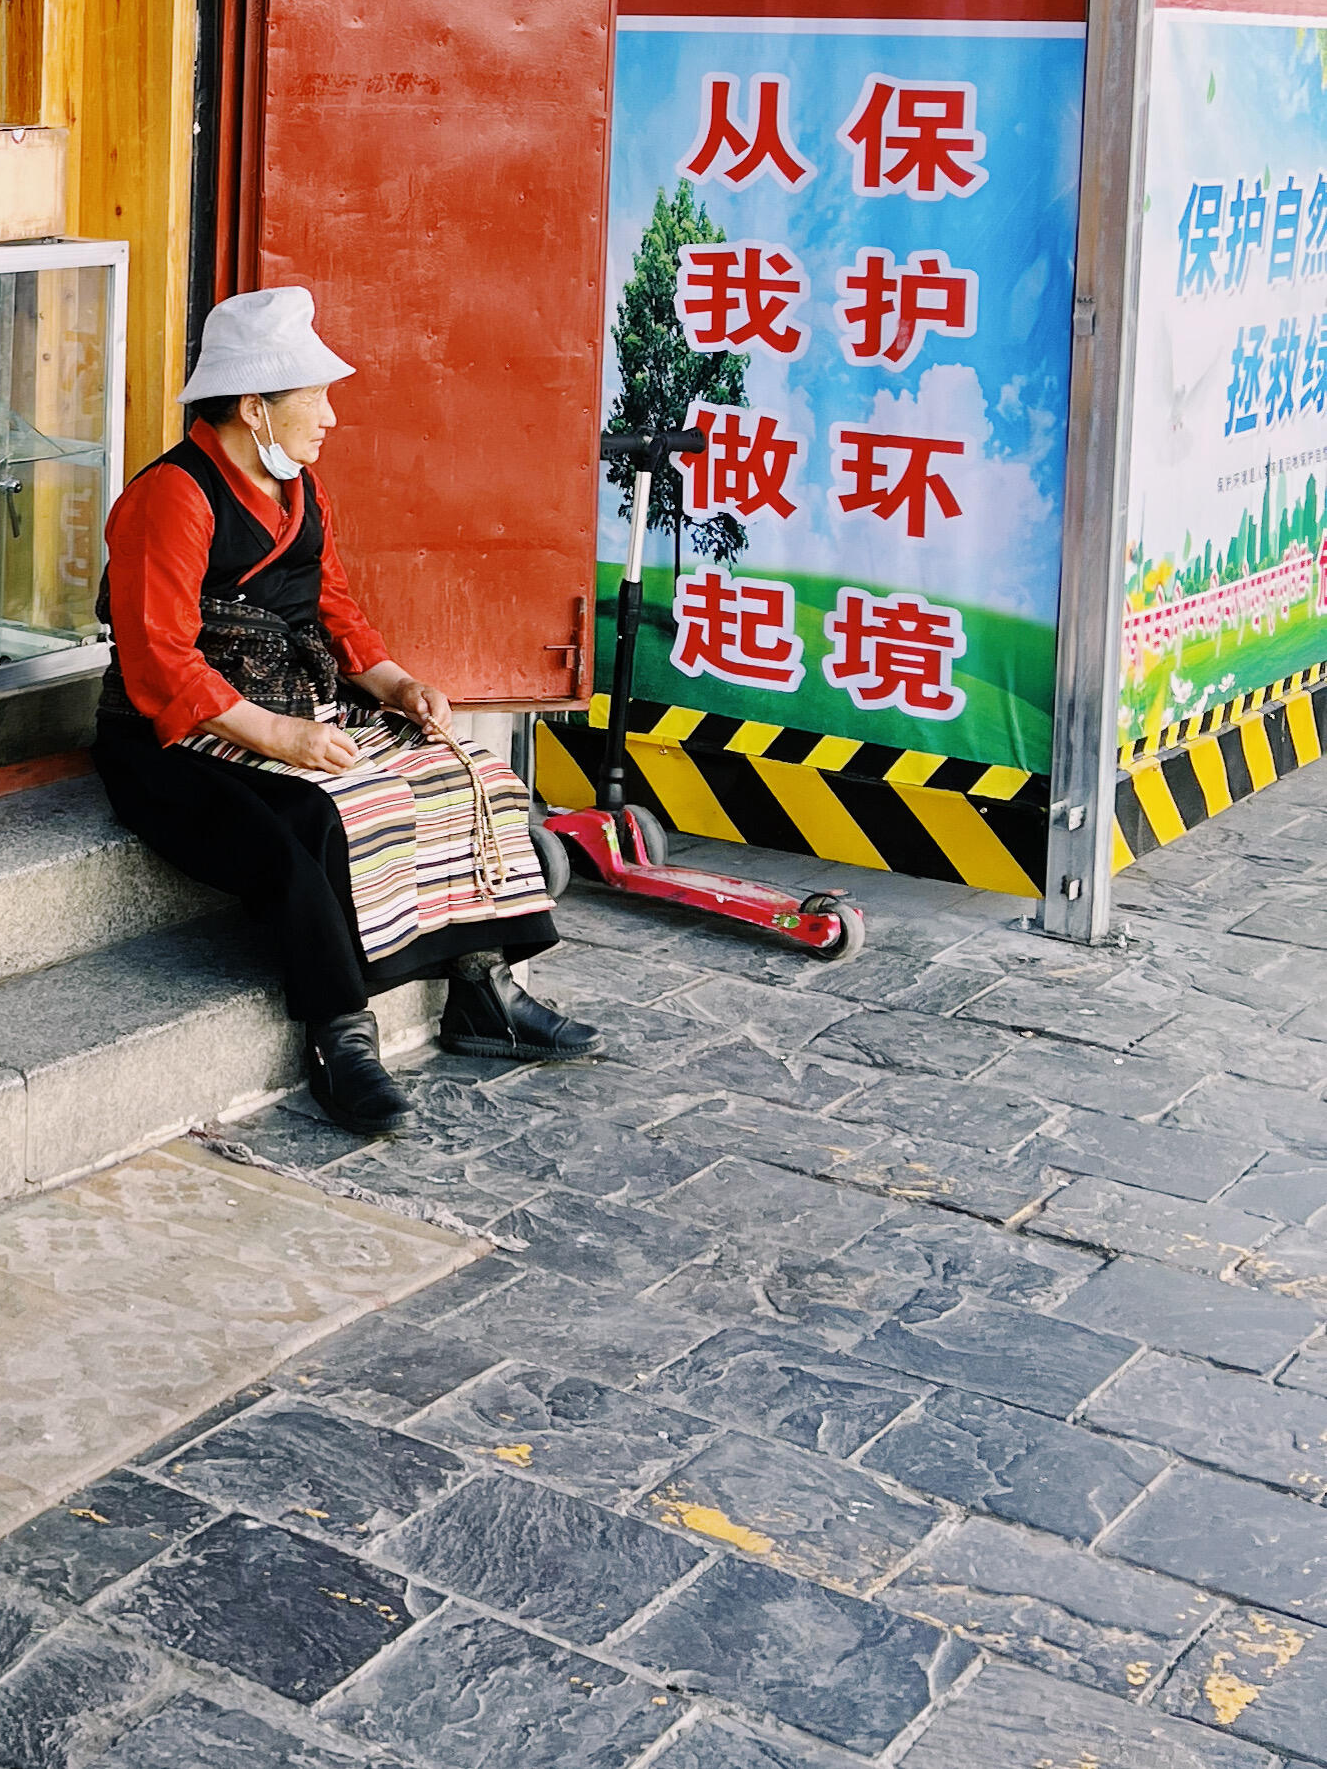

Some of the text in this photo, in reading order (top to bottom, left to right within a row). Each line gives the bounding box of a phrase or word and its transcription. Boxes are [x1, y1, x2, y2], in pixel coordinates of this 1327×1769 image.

[679, 81, 806, 684] 从我做起
[833, 82, 978, 713] 保护环境
